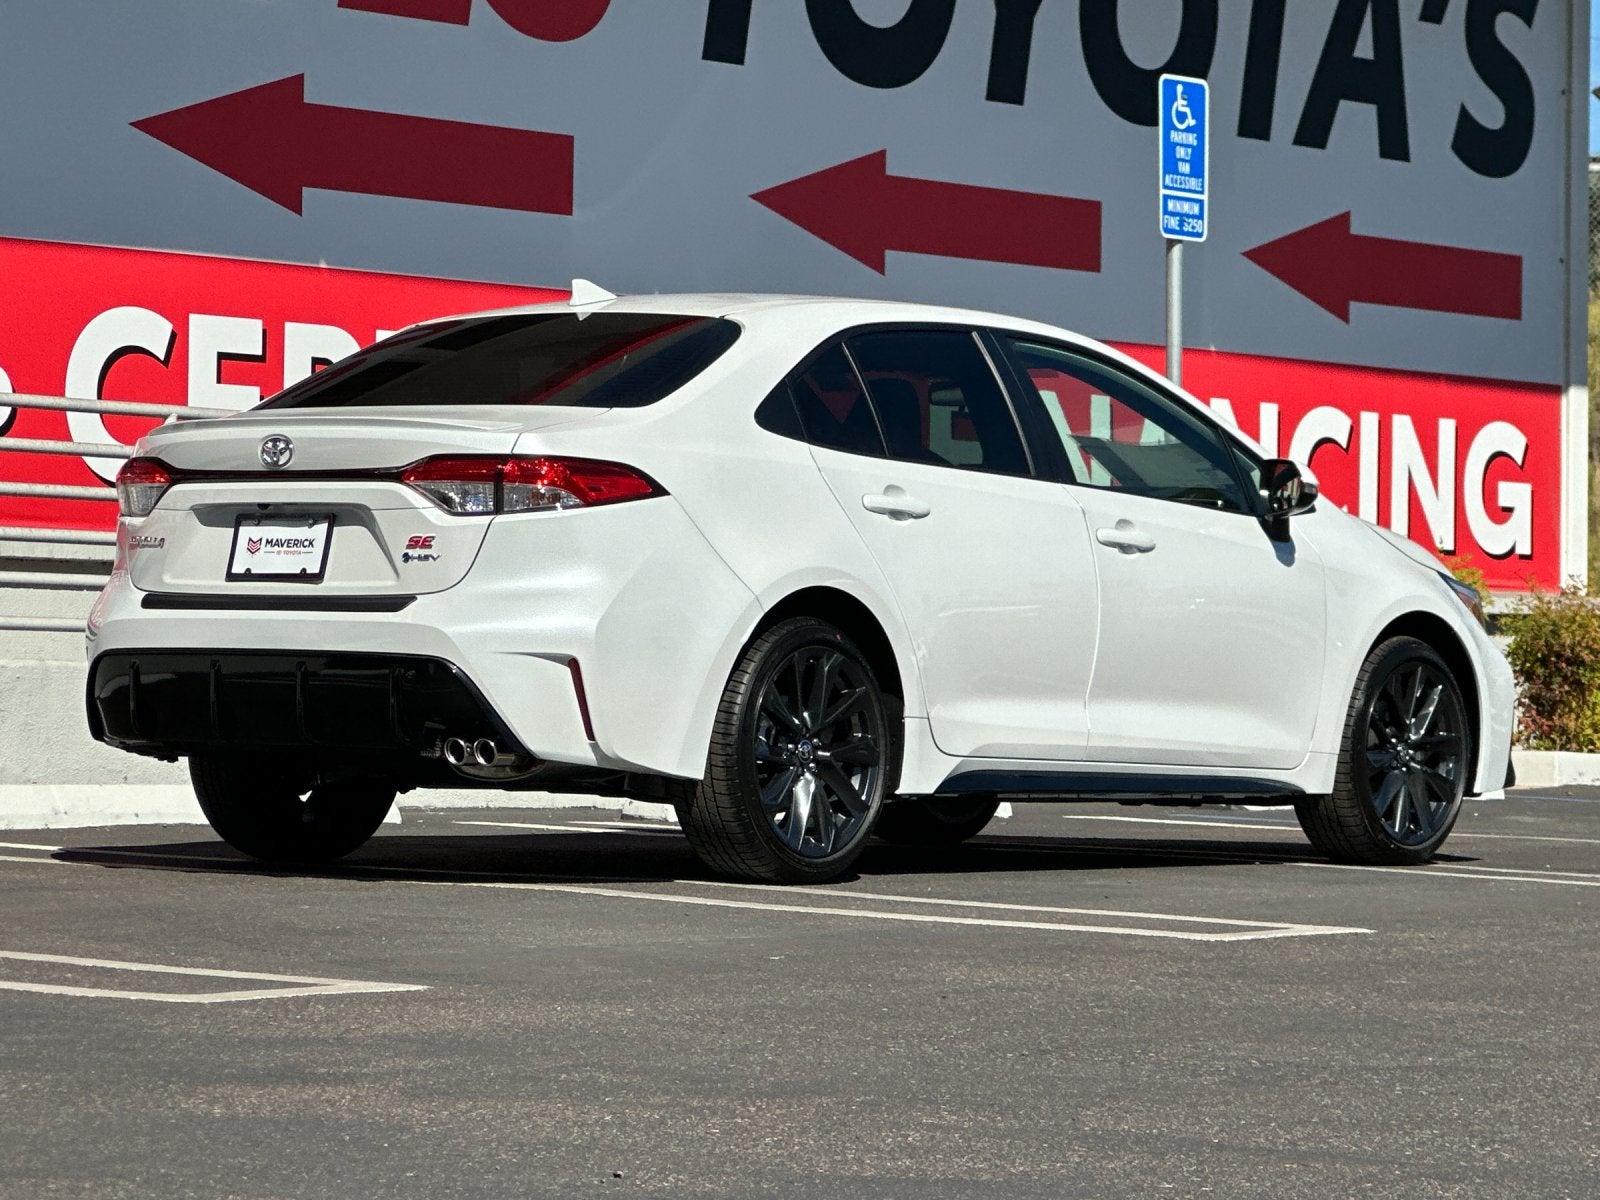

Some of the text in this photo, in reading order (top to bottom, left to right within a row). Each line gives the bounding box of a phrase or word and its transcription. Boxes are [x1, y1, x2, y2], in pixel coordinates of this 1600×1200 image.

[1170, 130, 1197, 146] PARKING
[1175, 145, 1192, 159] ONLY
[1178, 161, 1190, 174] VAN
[1165, 177, 1202, 190] ACCESSIBLE
[1167, 199, 1199, 215] MINIMUM
[1164, 215, 1179, 230] FINE
[264, 538, 315, 548] MAVERICK
[406, 535, 435, 549] SE
